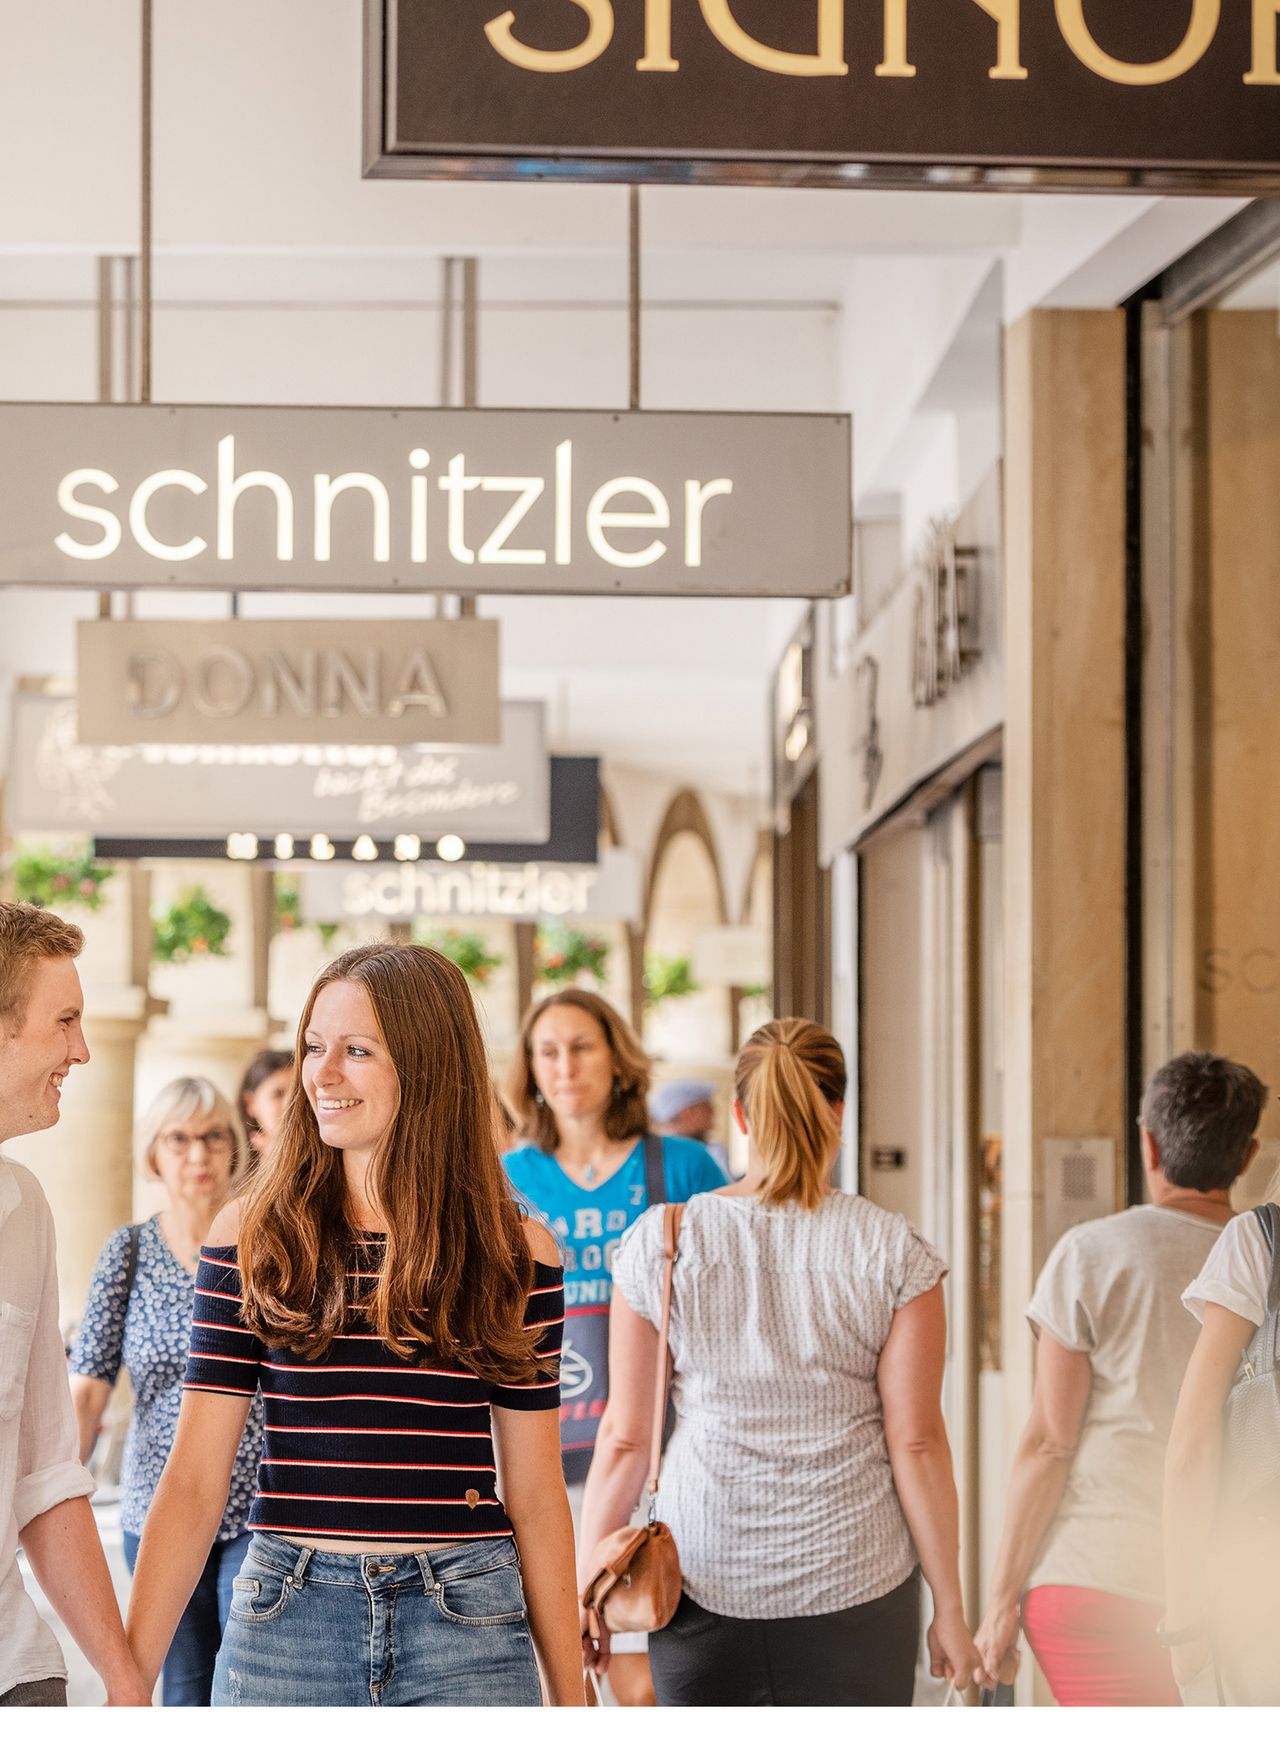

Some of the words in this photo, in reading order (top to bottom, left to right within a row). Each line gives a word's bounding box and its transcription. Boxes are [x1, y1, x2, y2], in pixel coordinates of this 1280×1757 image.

[53, 433, 733, 569] schnitzler
[125, 645, 449, 718] DONNA
[227, 832, 466, 862] MILANO
[342, 861, 599, 916] schnitzler
[540, 1208, 627, 1239] ARD
